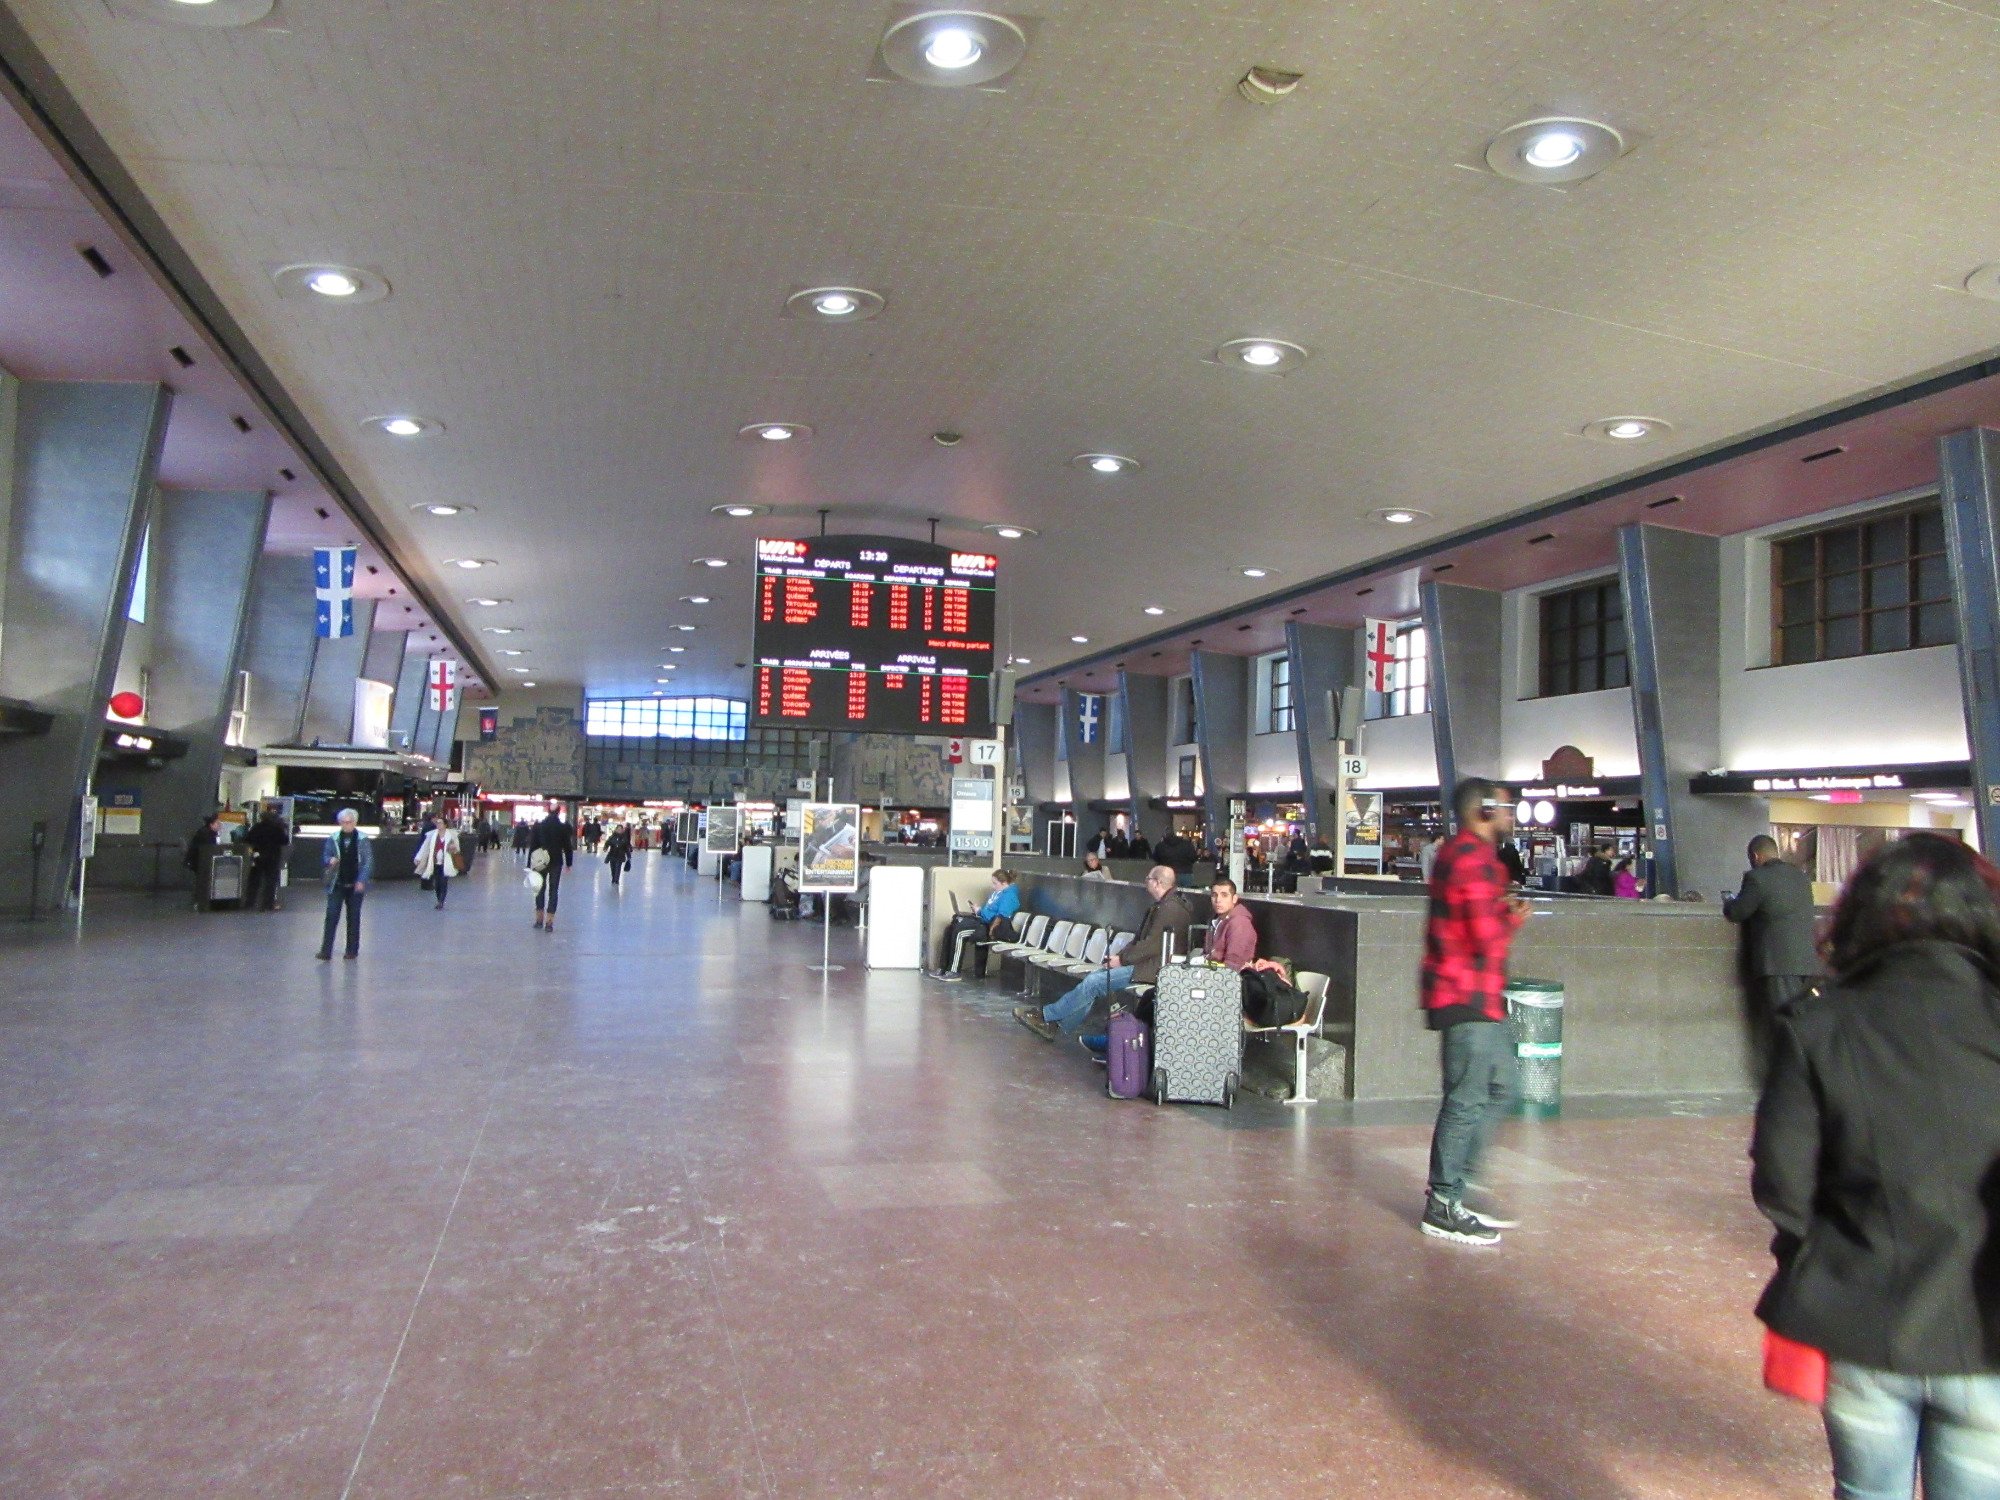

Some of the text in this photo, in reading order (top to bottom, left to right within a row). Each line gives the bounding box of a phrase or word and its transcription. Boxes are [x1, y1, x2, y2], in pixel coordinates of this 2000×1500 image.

[759, 540, 795, 554] VIA
[815, 559, 851, 570] DÉPARTS
[951, 553, 985, 568] VIA
[894, 565, 944, 576] DEPARTURES
[966, 643, 990, 651] partant
[810, 649, 850, 660] ARRIVÉES
[897, 654, 936, 664] ARRIVALS
[978, 745, 996, 760] 17
[1345, 760, 1361, 774] 18
[802, 781, 812, 789] 15
[1011, 788, 1021, 796] 16
